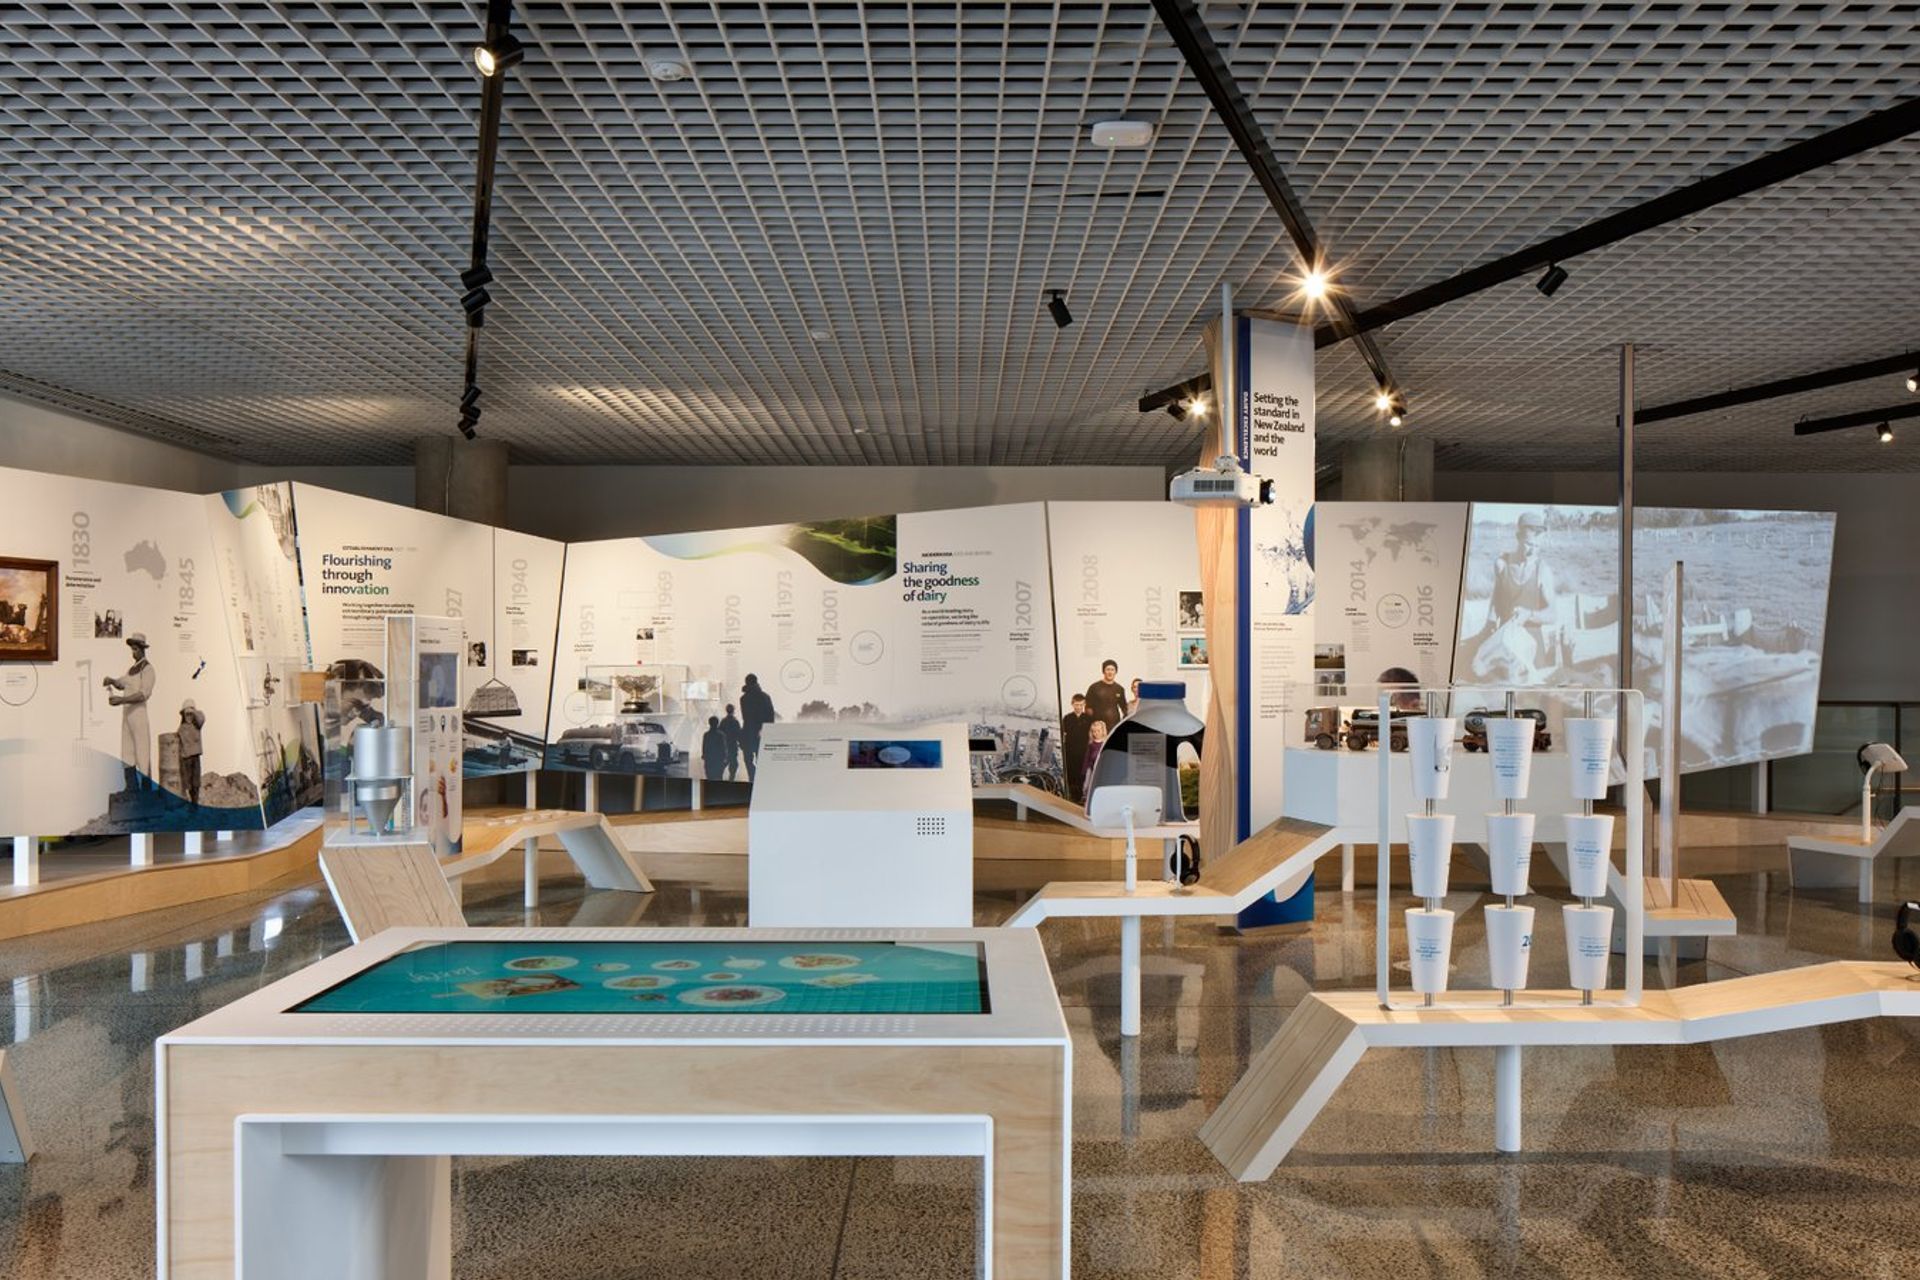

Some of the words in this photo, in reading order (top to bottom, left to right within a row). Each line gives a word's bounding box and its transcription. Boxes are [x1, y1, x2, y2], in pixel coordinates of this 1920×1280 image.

[1254, 392, 1284, 408] Setting
[1285, 395, 1299, 406] the
[1254, 407, 1290, 419] standard
[1292, 409, 1300, 419] in
[1254, 419, 1273, 430] New
[1273, 421, 1305, 433] Zealand
[1254, 433, 1269, 443] and
[1271, 433, 1285, 444] the
[1254, 446, 1278, 457] world
[72, 512, 90, 568] 1830
[322, 554, 392, 571] Flourishing
[322, 569, 373, 584] through
[512, 558, 528, 601] 1940
[903, 561, 948, 576] Sharing
[1082, 555, 1098, 601] 2008
[1350, 560, 1366, 601] 2014
[179, 558, 195, 609] 1845
[322, 583, 389, 596] innovation
[658, 571, 673, 611] 1969
[777, 570, 792, 609] 1973
[903, 590, 915, 602] of
[917, 590, 947, 604] dairy
[904, 577, 922, 588] the
[924, 575, 980, 591] goodness
[446, 587, 463, 617] 927
[725, 595, 741, 634] 1970
[823, 589, 839, 632] 2001
[1015, 580, 1031, 626] 2007
[1145, 586, 1162, 627] 2012
[1416, 584, 1434, 628] 2016
[580, 604, 594, 640] 1951
